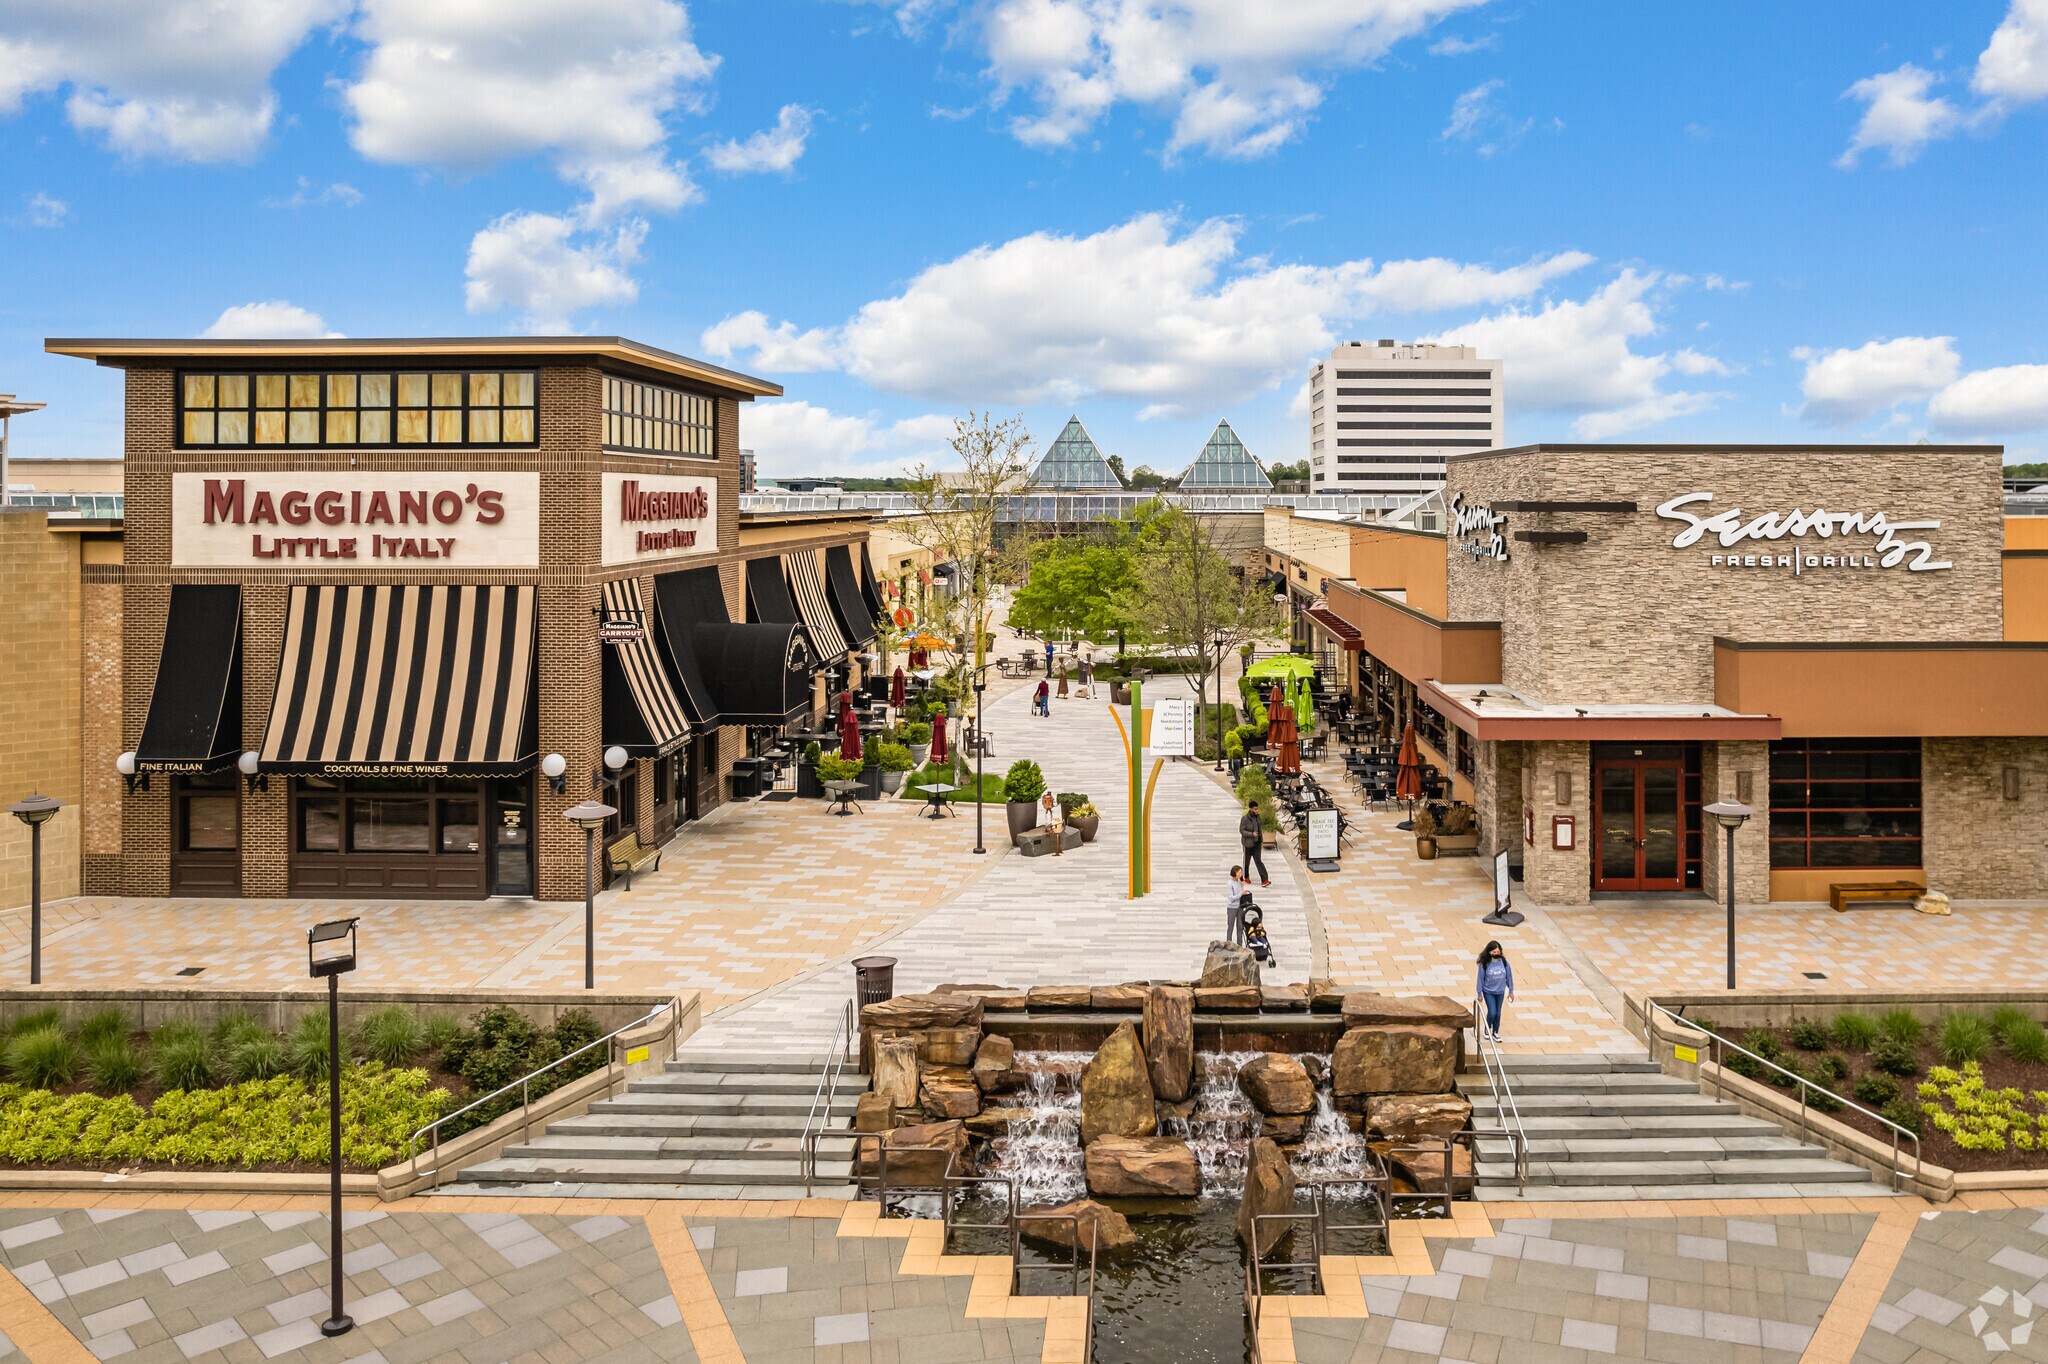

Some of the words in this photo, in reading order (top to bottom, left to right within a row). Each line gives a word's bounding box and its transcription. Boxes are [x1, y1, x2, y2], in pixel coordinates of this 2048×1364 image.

[203, 479, 505, 525] MAGGIANO'S
[622, 480, 708, 521] MAGGIANO'S
[636, 531, 672, 551] LITTLE
[672, 528, 697, 547] ITALY
[1656, 492, 1941, 548] Seasons
[1875, 529, 1953, 572] 52
[252, 534, 357, 558] LITTLE
[372, 534, 456, 558] ITALY
[1711, 555, 1791, 567] FRESH
[1805, 555, 1874, 567] GRILL
[140, 763, 162, 771] FINE
[324, 765, 380, 773] COCKTAILS
[381, 765, 389, 773] &
[390, 765, 414, 773] FINE
[415, 765, 448, 773] WINES
